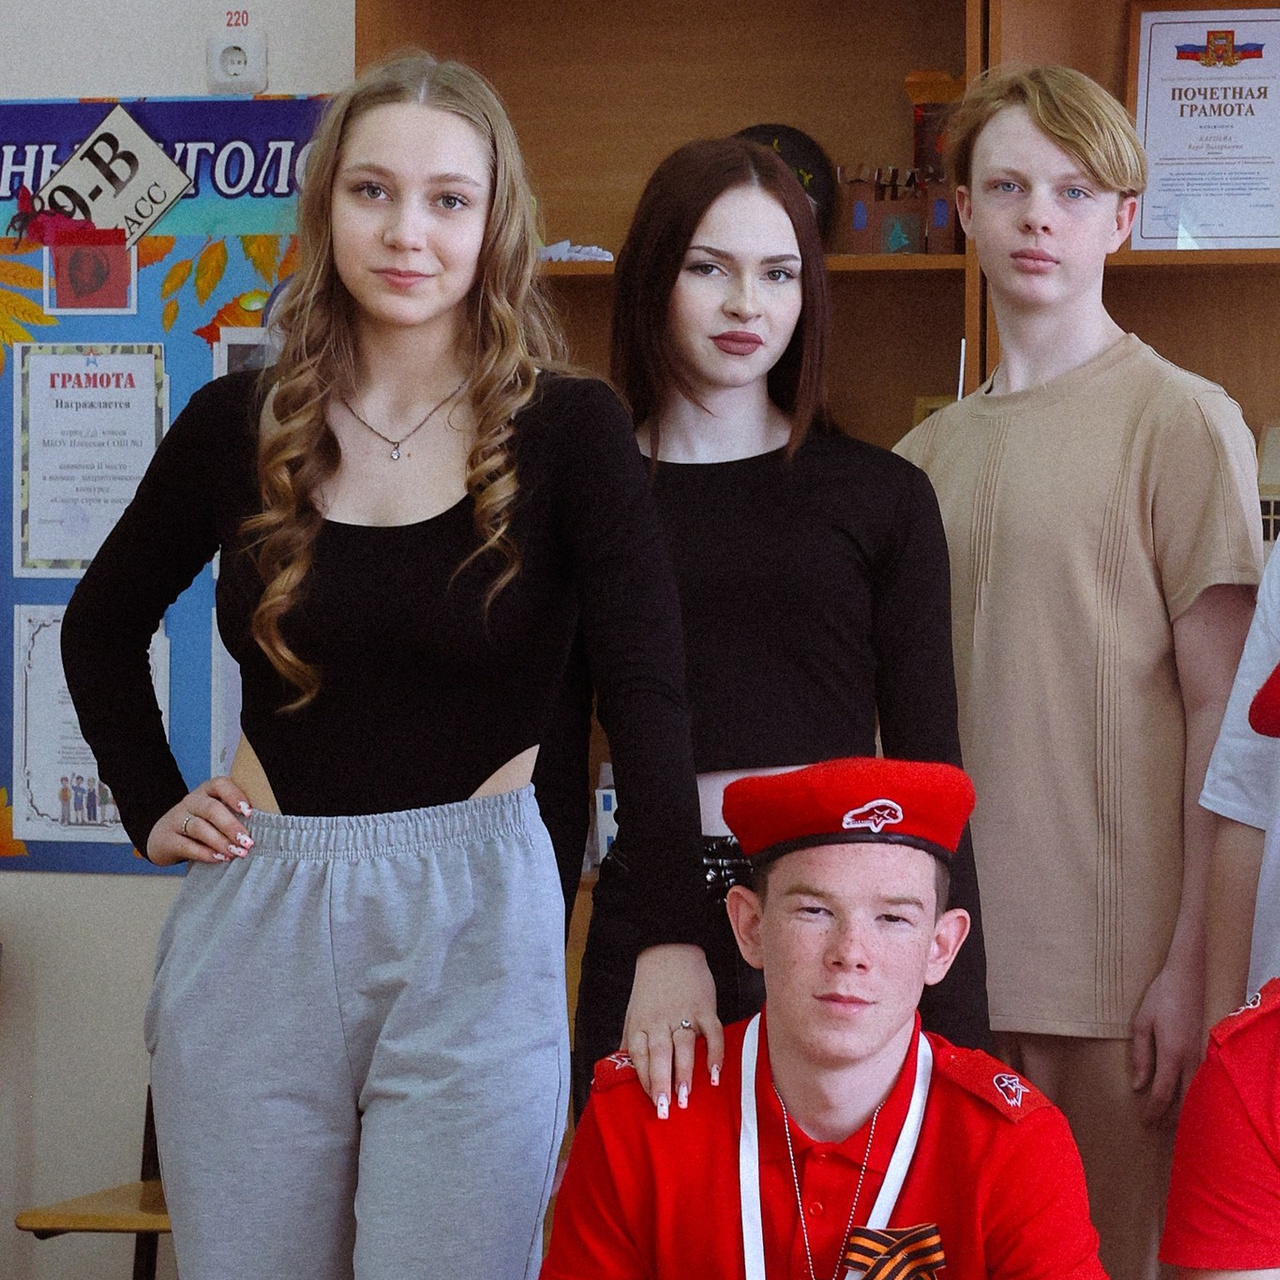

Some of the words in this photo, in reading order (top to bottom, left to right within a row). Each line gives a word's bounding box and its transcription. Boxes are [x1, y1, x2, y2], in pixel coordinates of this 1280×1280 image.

[226, 10, 249, 27] 220
[1171, 86, 1268, 101] ПОЧЕТНАЯ
[1179, 103, 1256, 117] ГРАМОТА
[173, 140, 312, 196] ГОЛ
[49, 372, 136, 389] ГРАМОТА
[55, 399, 131, 411] Награждается
